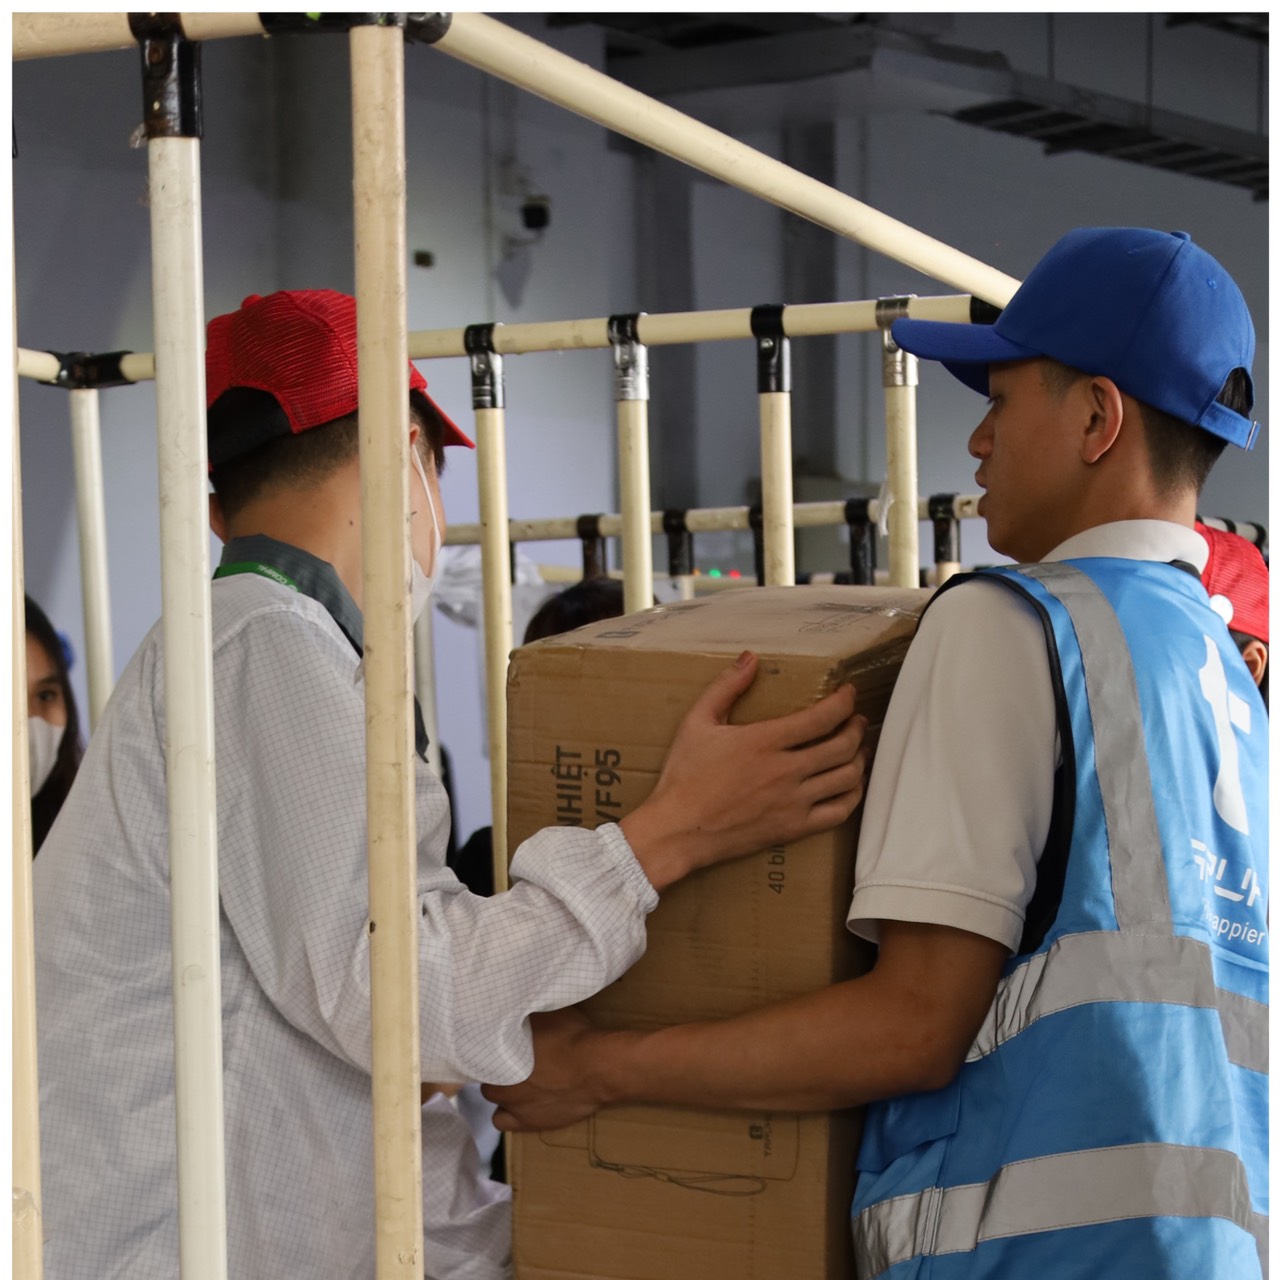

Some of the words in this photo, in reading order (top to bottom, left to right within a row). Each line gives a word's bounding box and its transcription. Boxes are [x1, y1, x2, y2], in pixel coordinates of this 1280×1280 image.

[1198, 634, 1251, 836] t
[595, 749, 622, 827] VF95
[768, 871, 785, 895] 40
